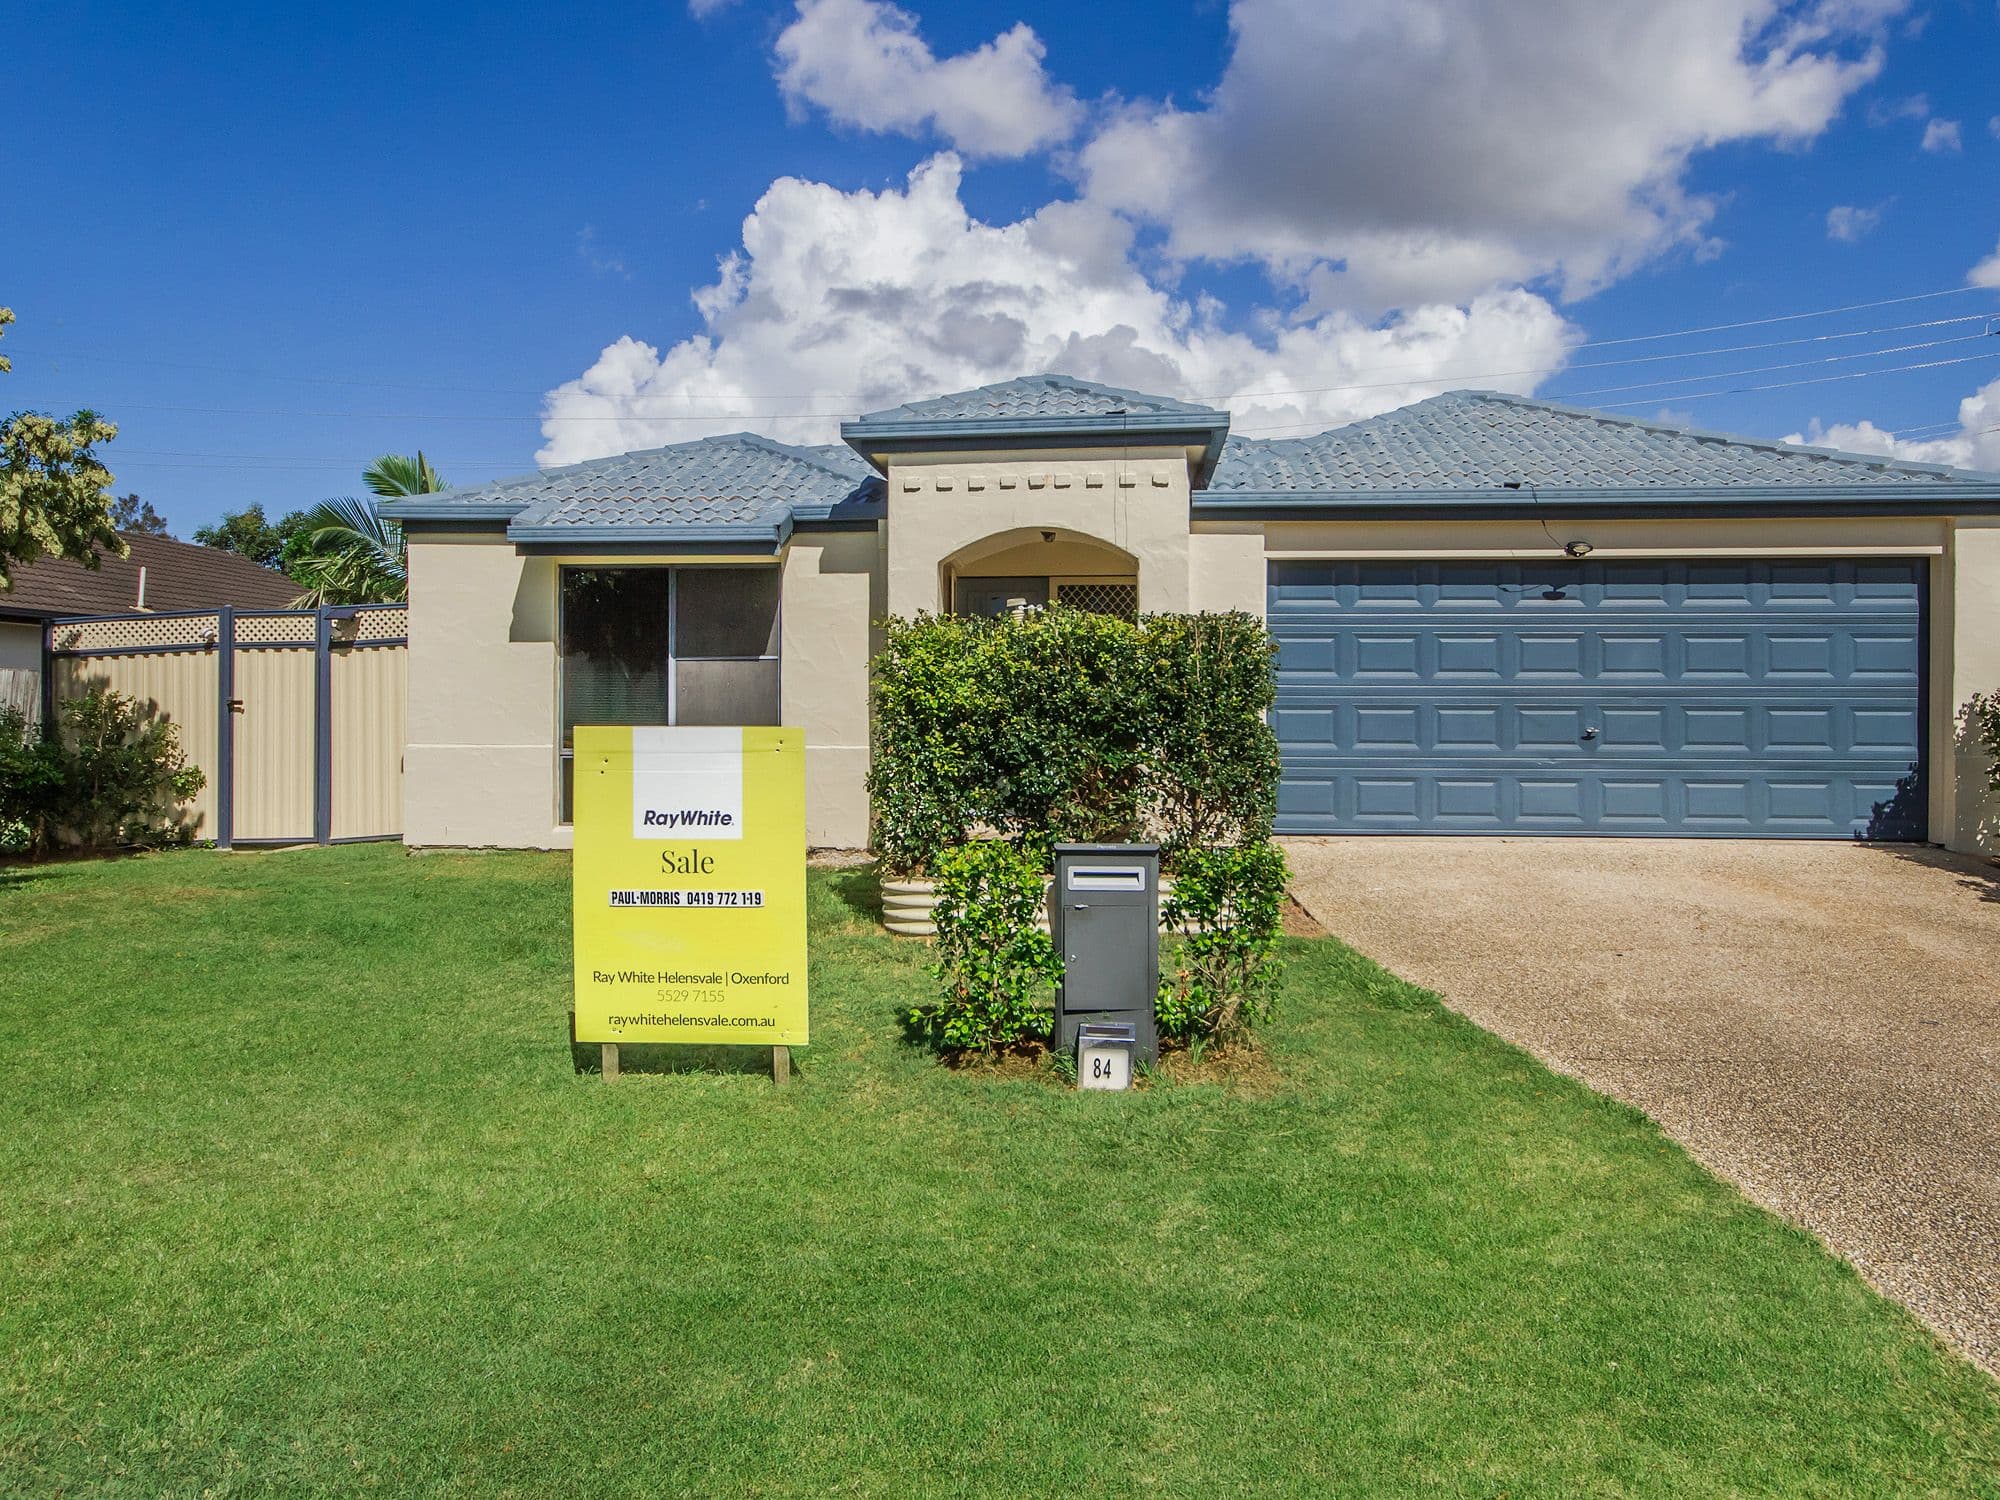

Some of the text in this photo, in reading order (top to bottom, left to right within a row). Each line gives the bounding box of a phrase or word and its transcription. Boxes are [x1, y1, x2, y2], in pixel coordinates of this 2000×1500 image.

[661, 848, 715, 874] Sale
[687, 892, 714, 905] 0419
[717, 892, 737, 905] 772
[593, 970, 615, 985] Ray
[617, 970, 655, 984] White
[658, 971, 723, 985] Helensvale
[731, 972, 789, 985] Oxenford
[657, 989, 725, 1003] 5529 7155
[608, 1013, 775, 1028] raywhitehelensvale.com.au
[1093, 1057, 1112, 1079] 84
